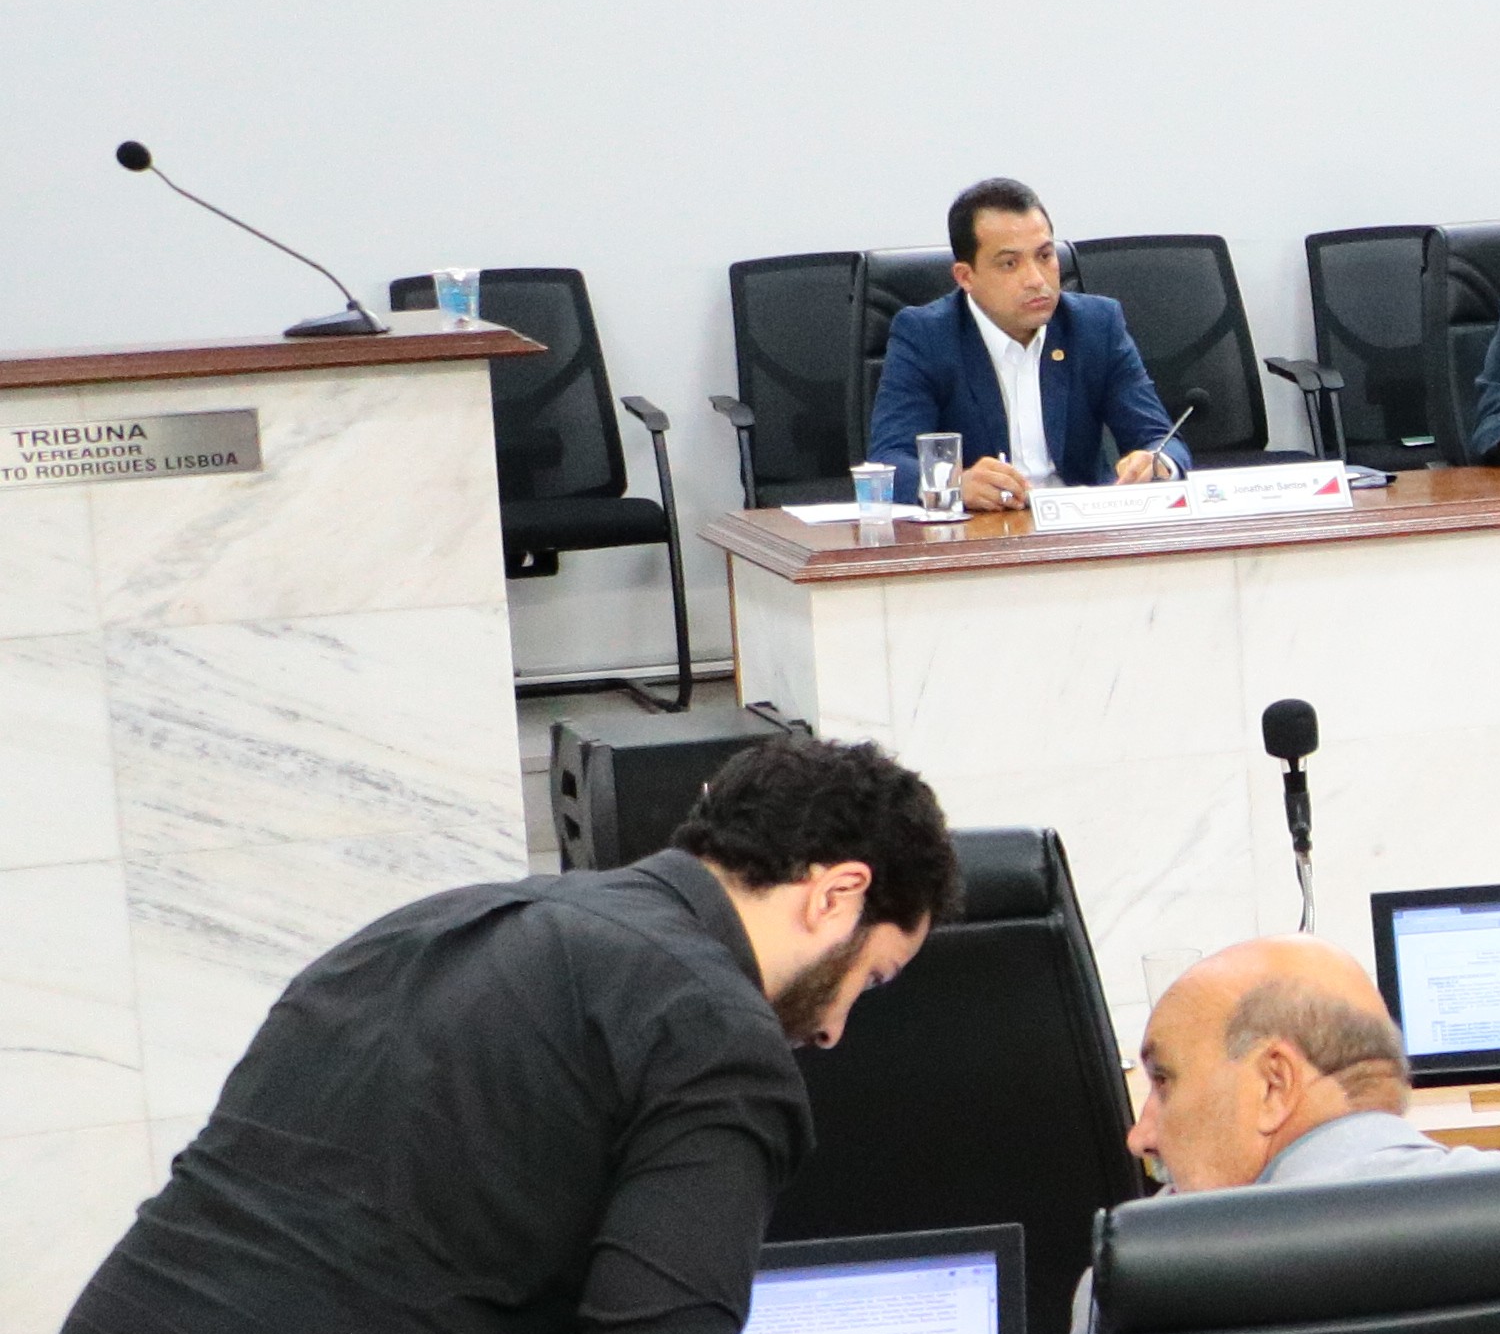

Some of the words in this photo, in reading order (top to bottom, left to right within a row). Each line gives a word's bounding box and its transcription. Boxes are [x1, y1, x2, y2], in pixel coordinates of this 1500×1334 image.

[12, 424, 148, 448] TRIBUNA
[20, 444, 143, 463] VEREADOR
[35, 458, 157, 479] RODRIGUES
[164, 452, 239, 471] LISBOA
[1233, 482, 1275, 495] Jonathan
